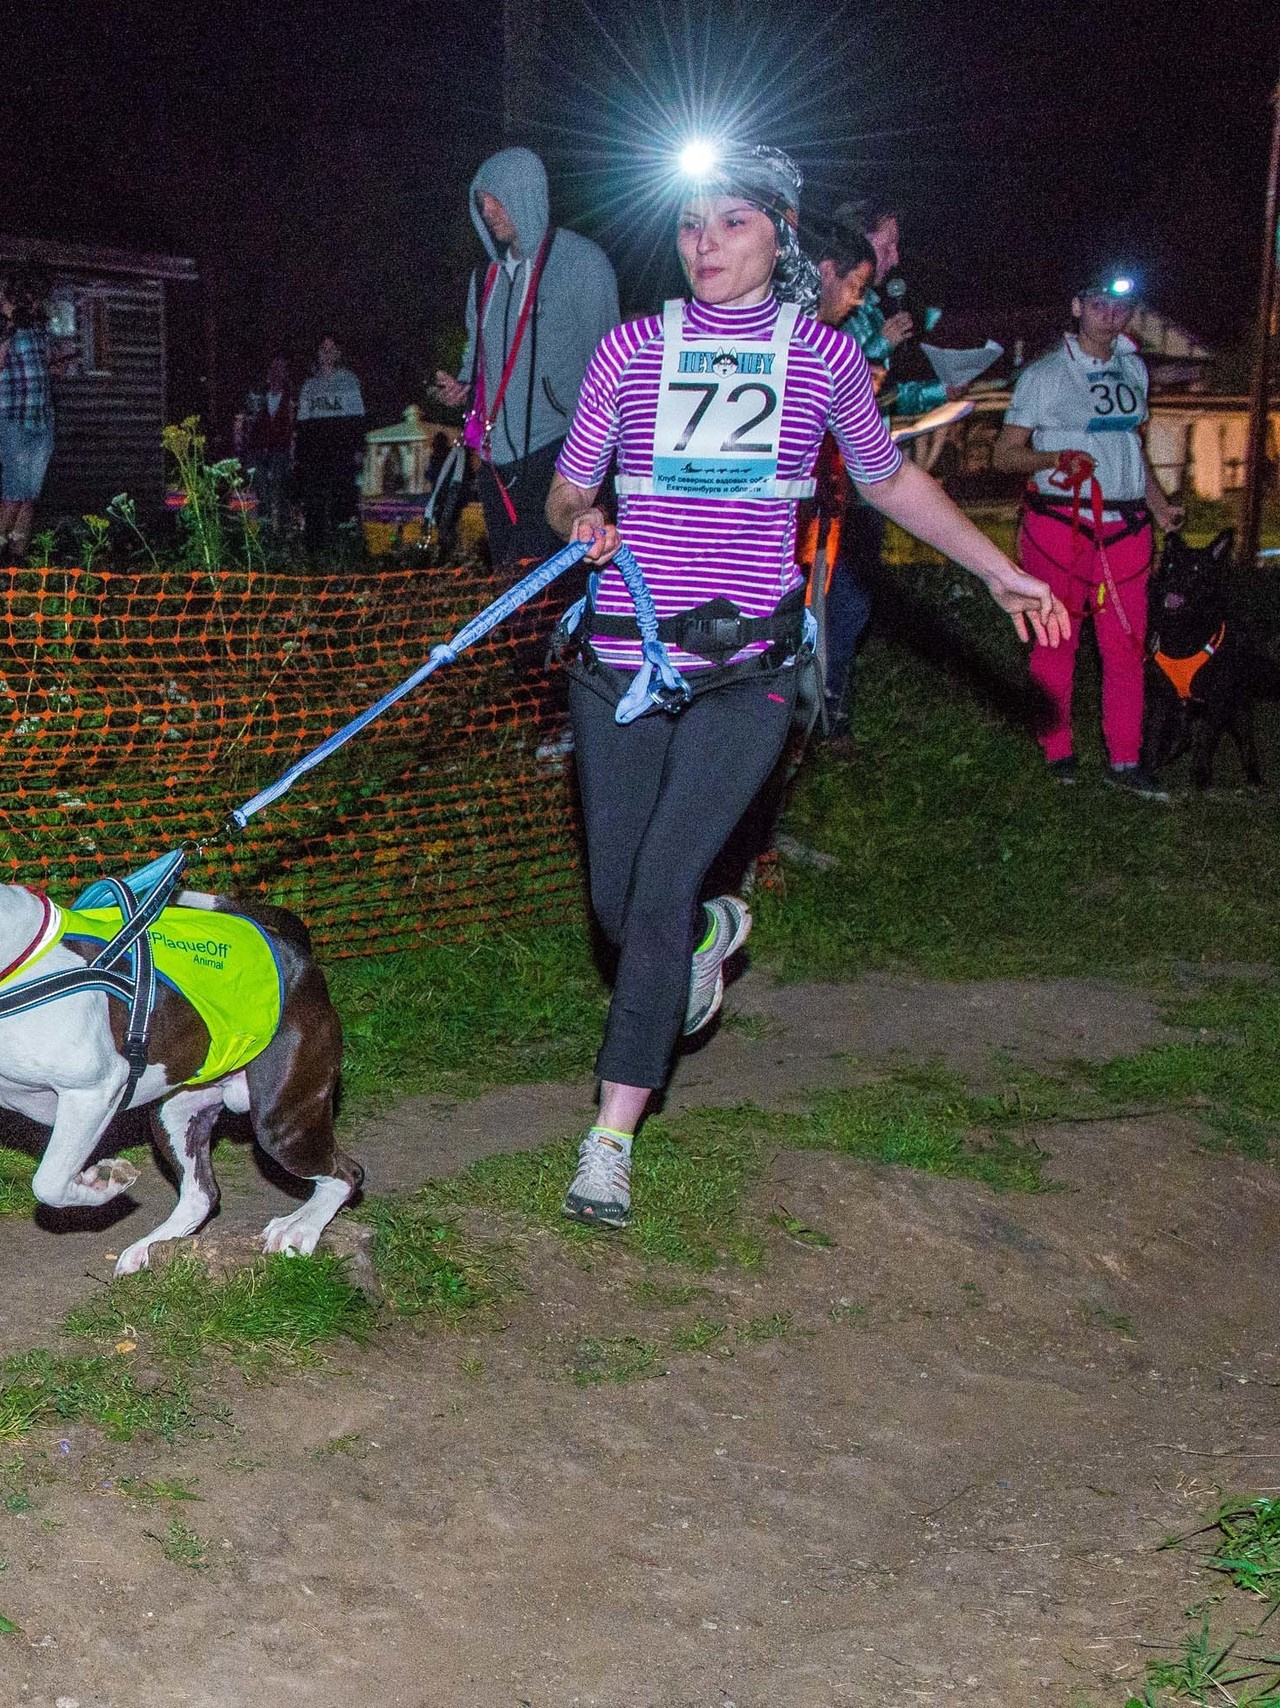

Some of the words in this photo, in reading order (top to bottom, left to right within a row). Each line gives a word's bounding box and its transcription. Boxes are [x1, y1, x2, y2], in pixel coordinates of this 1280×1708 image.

[678, 351, 716, 373] HEY
[735, 352, 776, 375] HEY
[1090, 383, 1137, 415] 30
[668, 382, 777, 453] 72
[657, 475, 676, 483] Клуб
[678, 477, 714, 485] северных
[666, 484, 721, 494] Екатеринбурга
[193, 954, 224, 970] Animal
